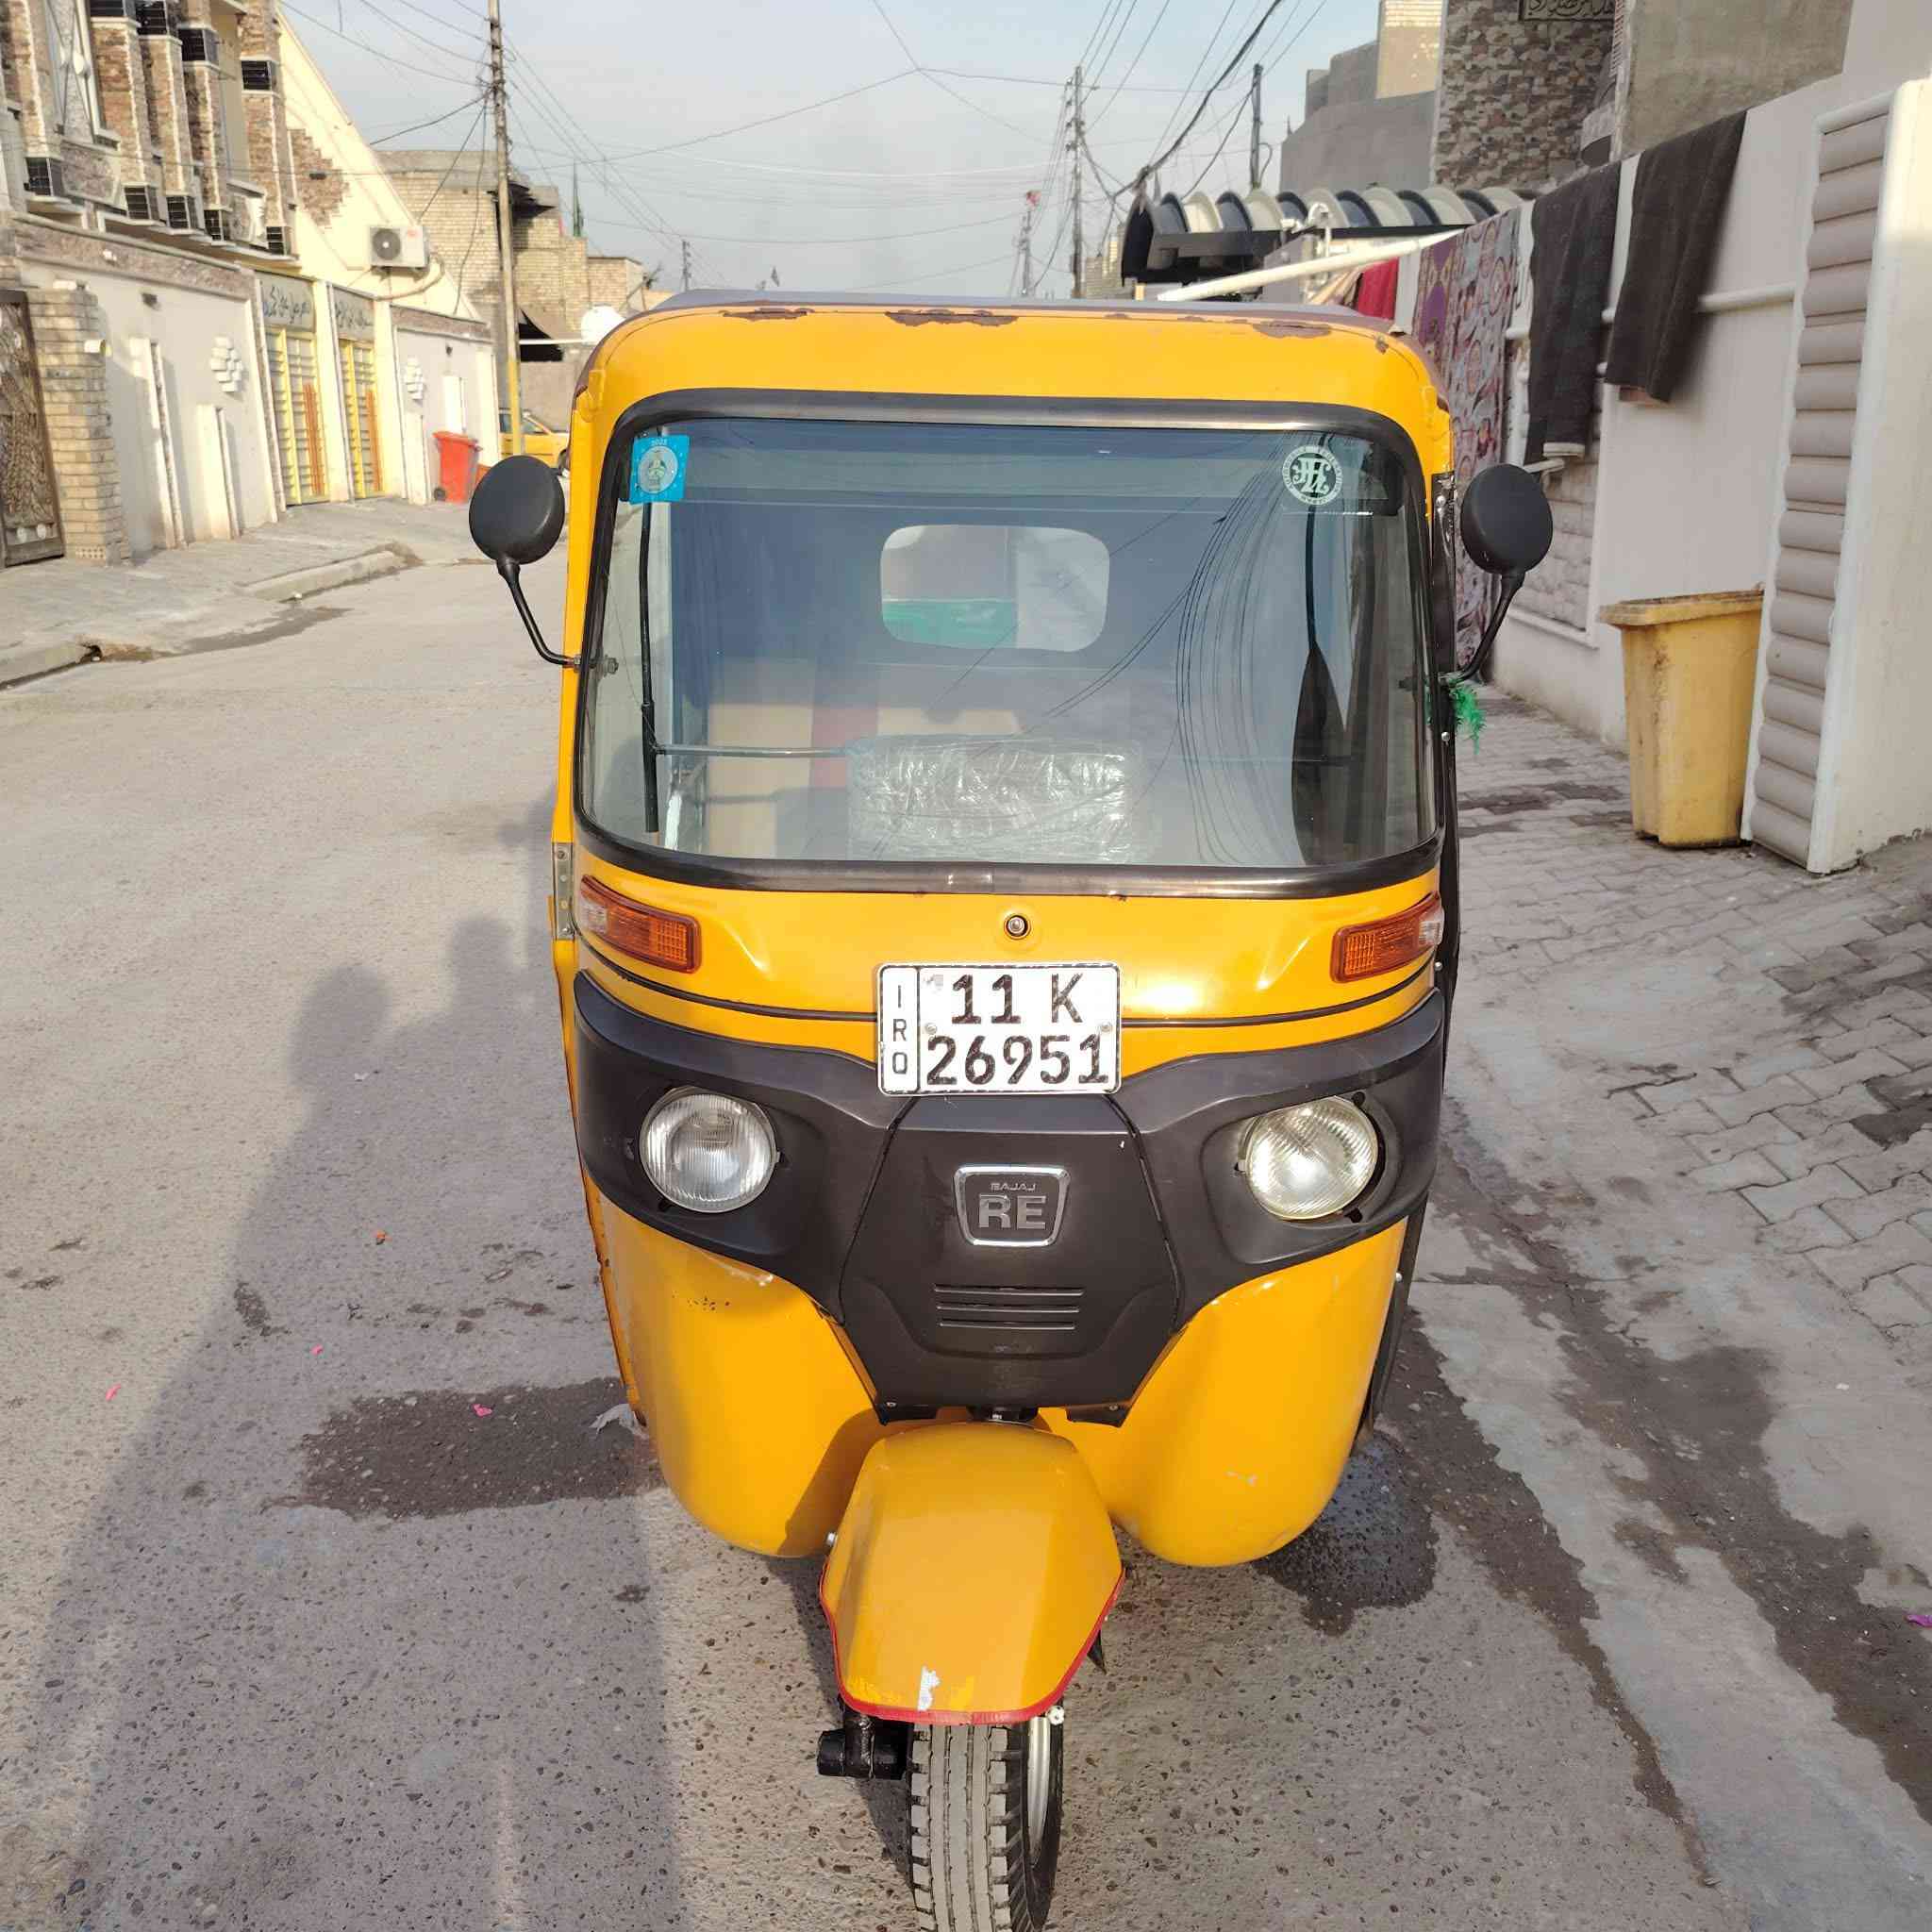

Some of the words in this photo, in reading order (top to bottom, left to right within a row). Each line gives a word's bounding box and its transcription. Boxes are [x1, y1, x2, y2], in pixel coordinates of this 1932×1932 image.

[951, 974, 1022, 1024] 11
[1051, 973, 1084, 1024] K
[926, 1034, 1109, 1086] 26951
[991, 1182, 1037, 1192] BAJAJ
[978, 1193, 1048, 1230] RE
